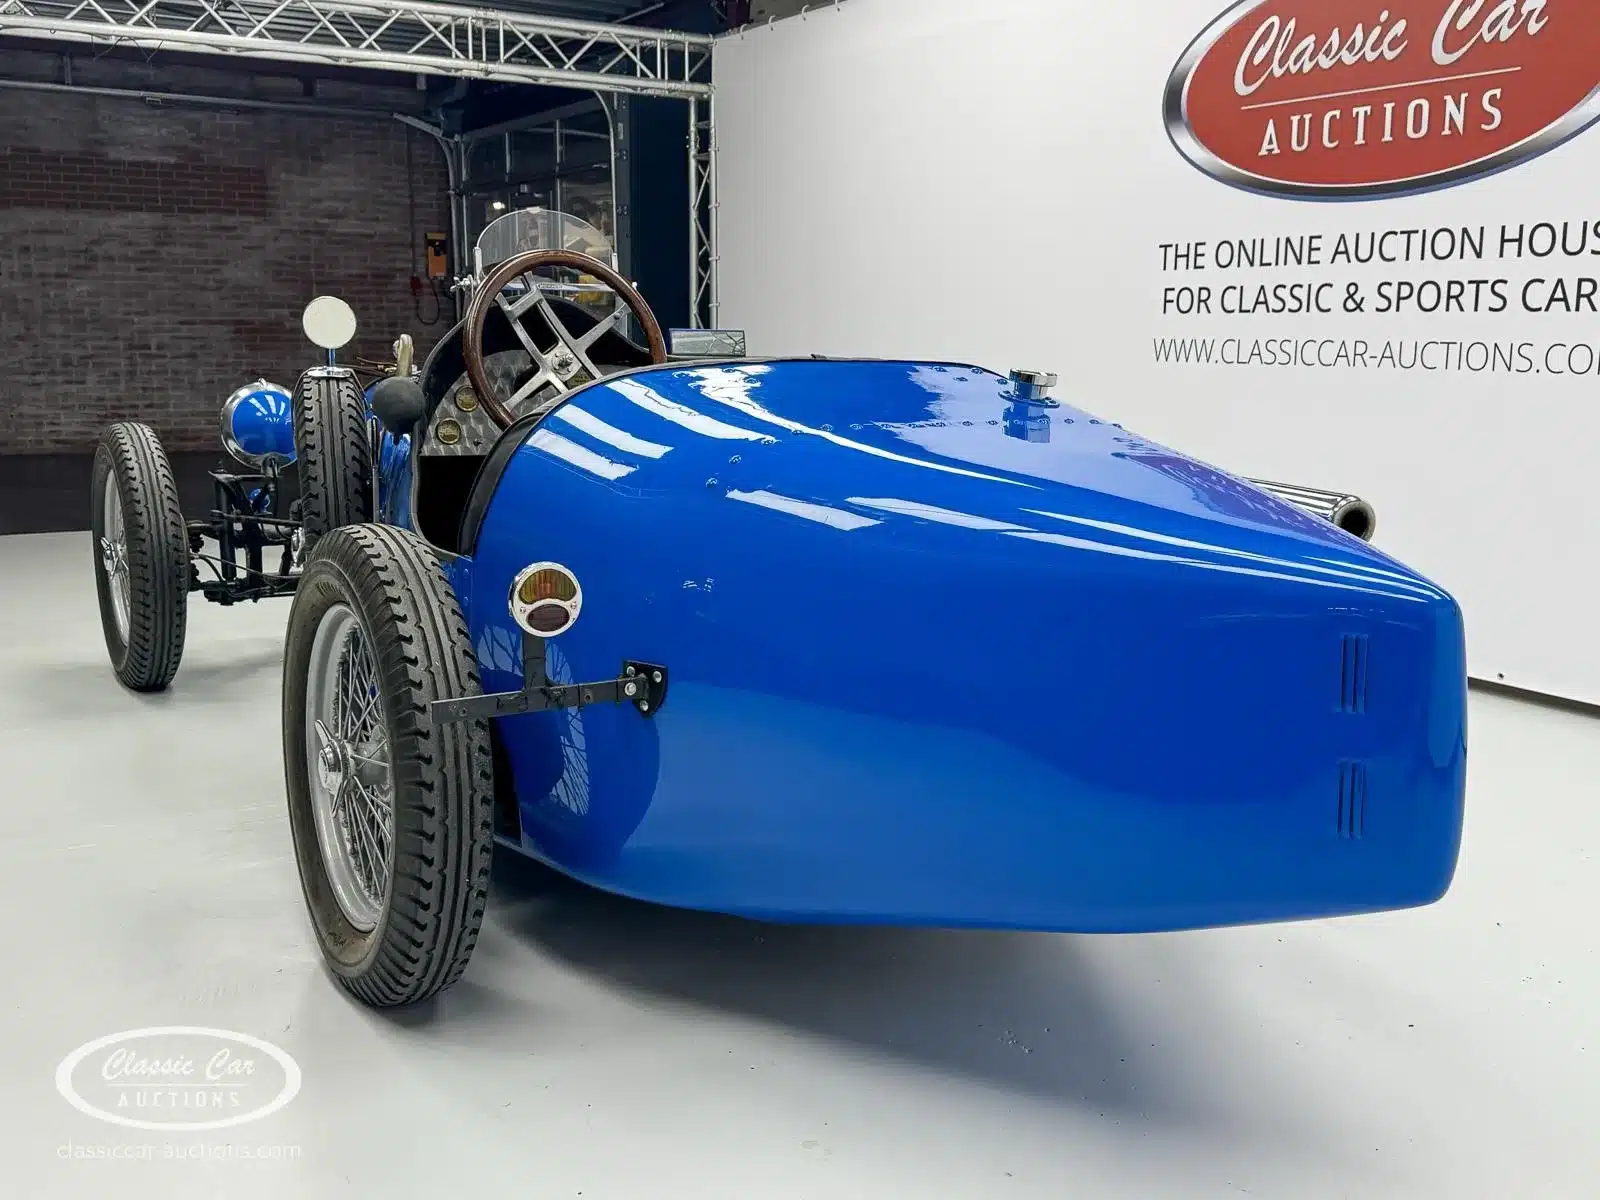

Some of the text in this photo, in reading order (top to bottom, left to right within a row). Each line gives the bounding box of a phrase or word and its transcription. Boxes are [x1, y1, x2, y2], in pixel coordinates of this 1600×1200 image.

[1234, 0, 1549, 96] Classic Car
[1258, 88, 1502, 156] AUCTIONS
[1158, 241, 1207, 271] THE
[1214, 235, 1323, 269] ONLINE
[1330, 226, 1485, 265] AUCTION
[1162, 286, 1212, 315] FOR
[1220, 282, 1334, 314] CLASSIC
[1342, 281, 1366, 313] &
[1375, 279, 1509, 313] SPORTS
[1153, 338, 1600, 376] WWW.CLASSICCAR-AUCTIONS.CO
